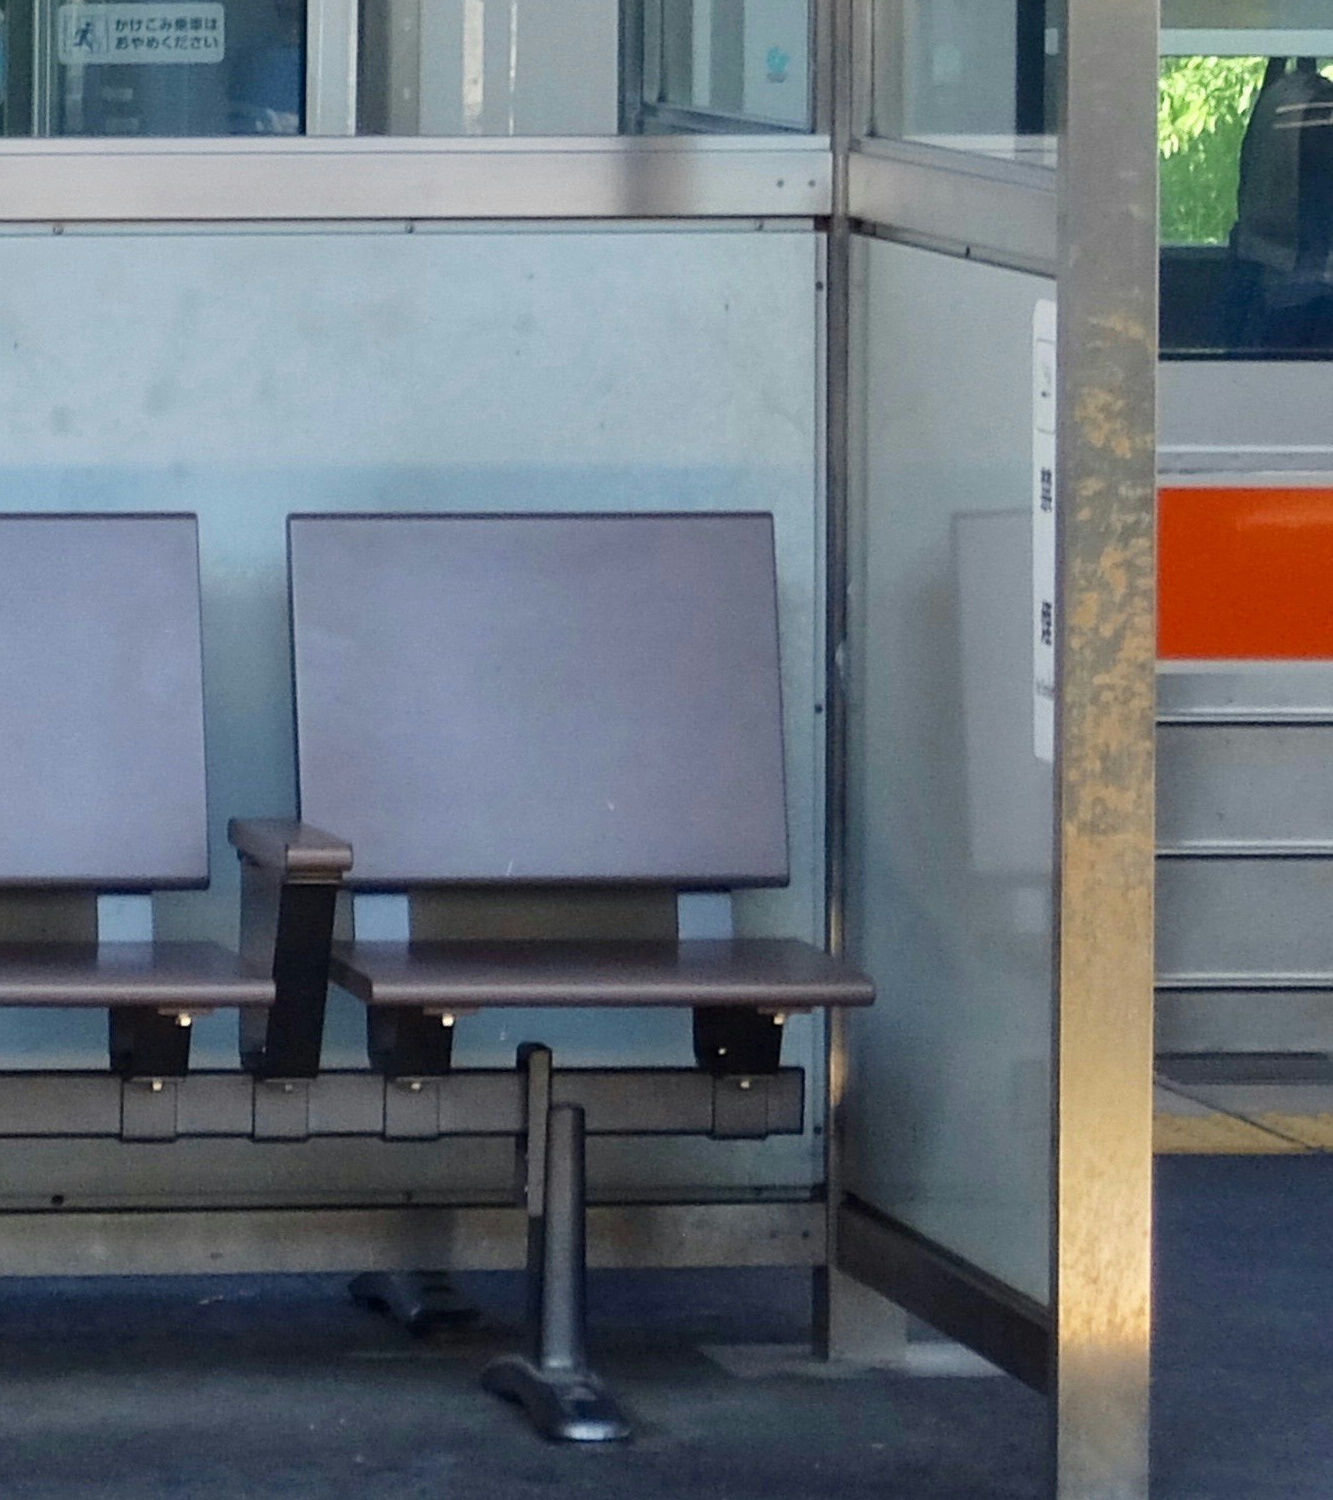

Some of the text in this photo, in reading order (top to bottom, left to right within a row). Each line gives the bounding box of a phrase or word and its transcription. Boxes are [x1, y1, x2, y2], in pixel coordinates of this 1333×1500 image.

[115, 17, 217, 31] かけこみ乗車は
[115, 36, 218, 49] おやめください
